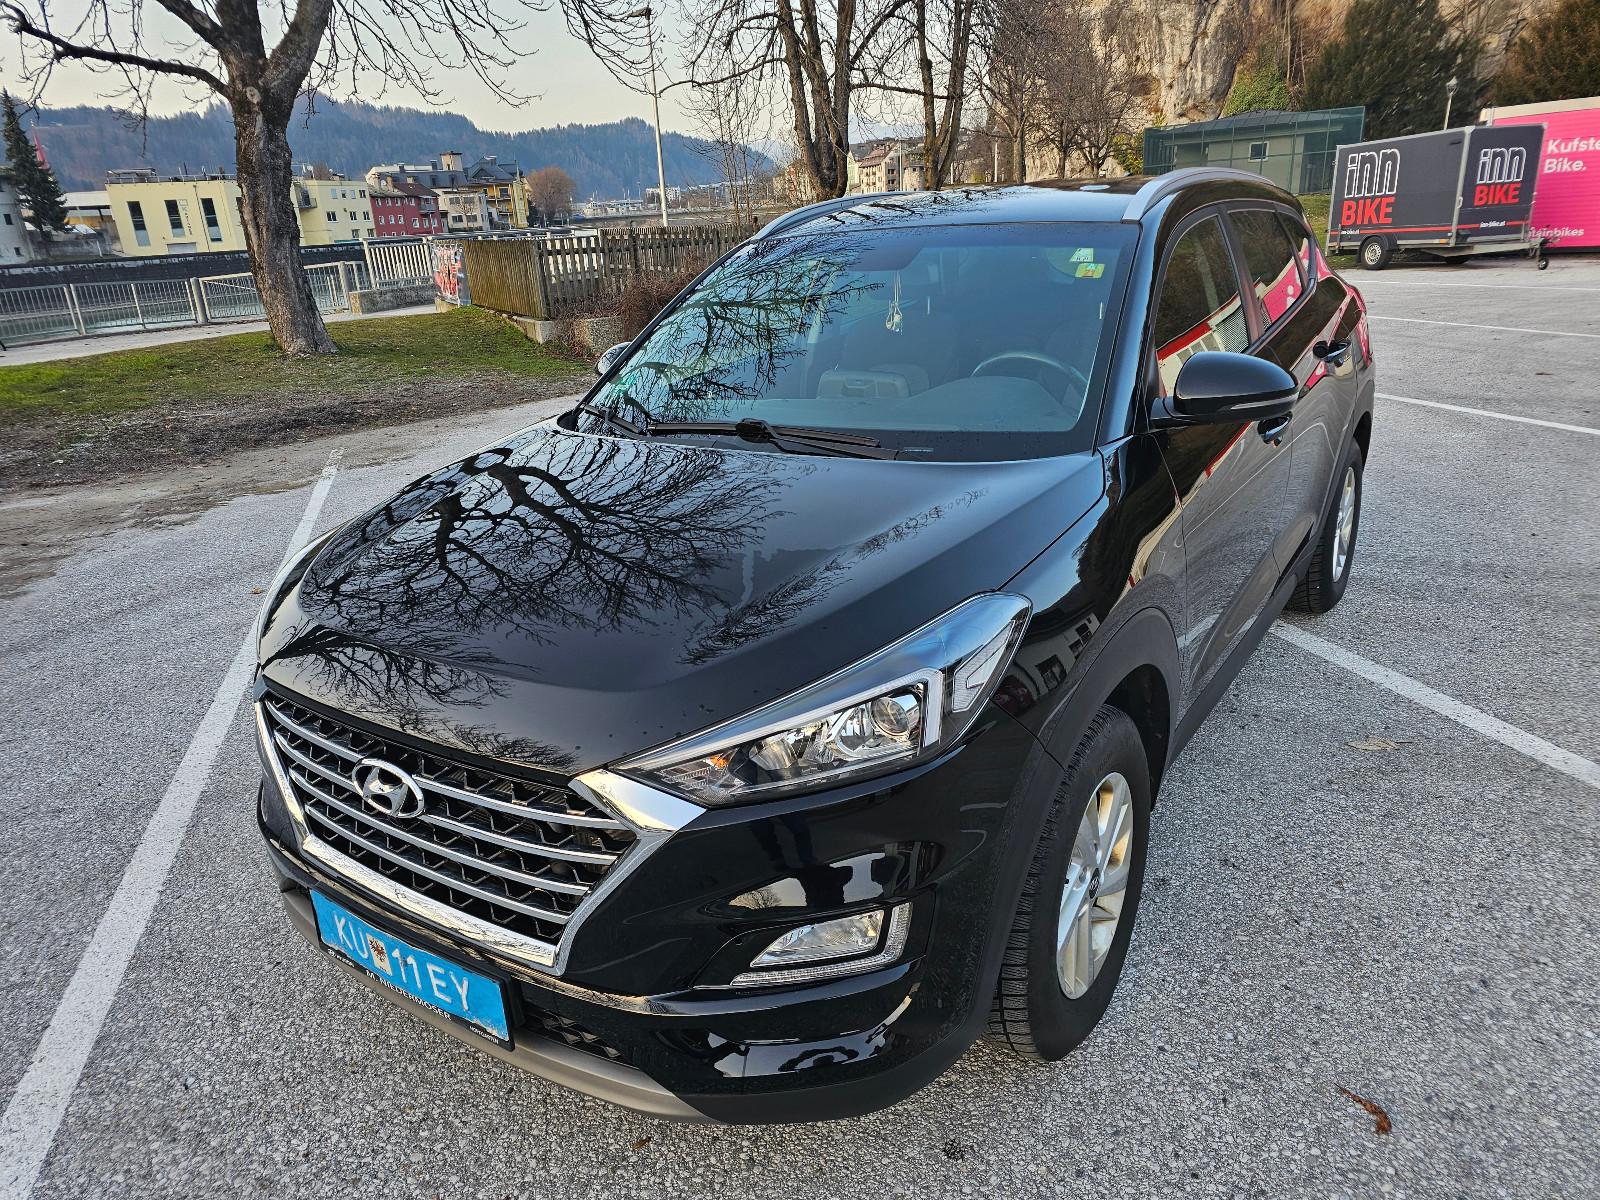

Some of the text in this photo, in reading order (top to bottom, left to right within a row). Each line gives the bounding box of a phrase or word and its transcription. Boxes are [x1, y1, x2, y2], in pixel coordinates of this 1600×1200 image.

[1344, 149, 1400, 198] inn
[1476, 147, 1526, 184] inn
[1543, 158, 1587, 174] Bike.
[1473, 182, 1521, 207] BIKE
[1341, 197, 1395, 225] BIKE
[333, 911, 469, 1012] KU 11EY
